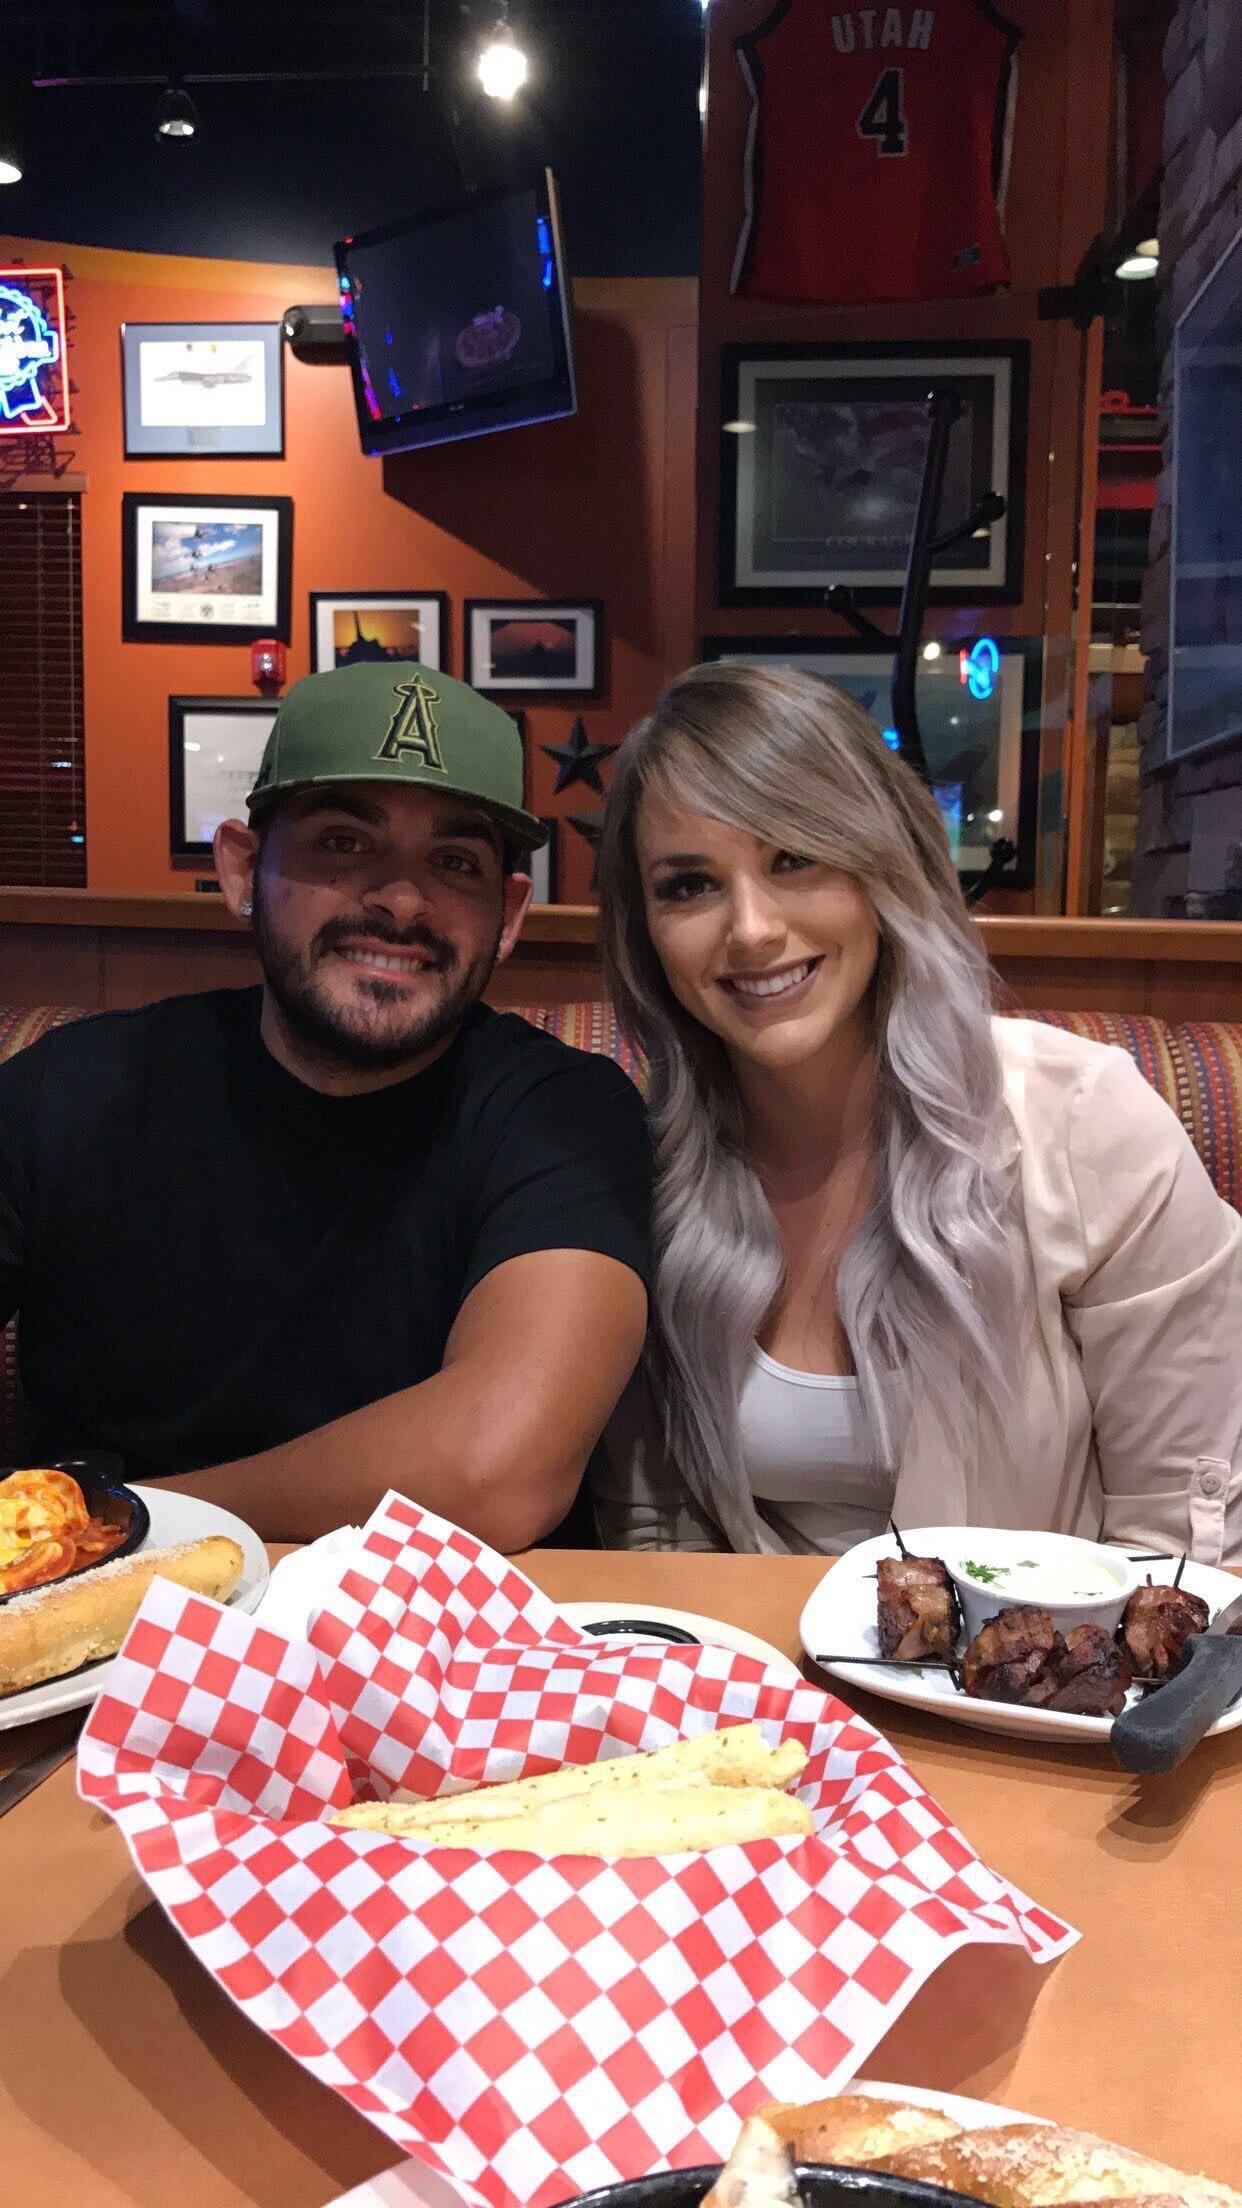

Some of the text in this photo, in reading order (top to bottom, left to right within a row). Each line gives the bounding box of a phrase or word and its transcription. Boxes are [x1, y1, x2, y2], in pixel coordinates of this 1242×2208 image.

[832, 8, 936, 53] UTAH
[855, 67, 908, 159] 4
[370, 672, 448, 775] A
